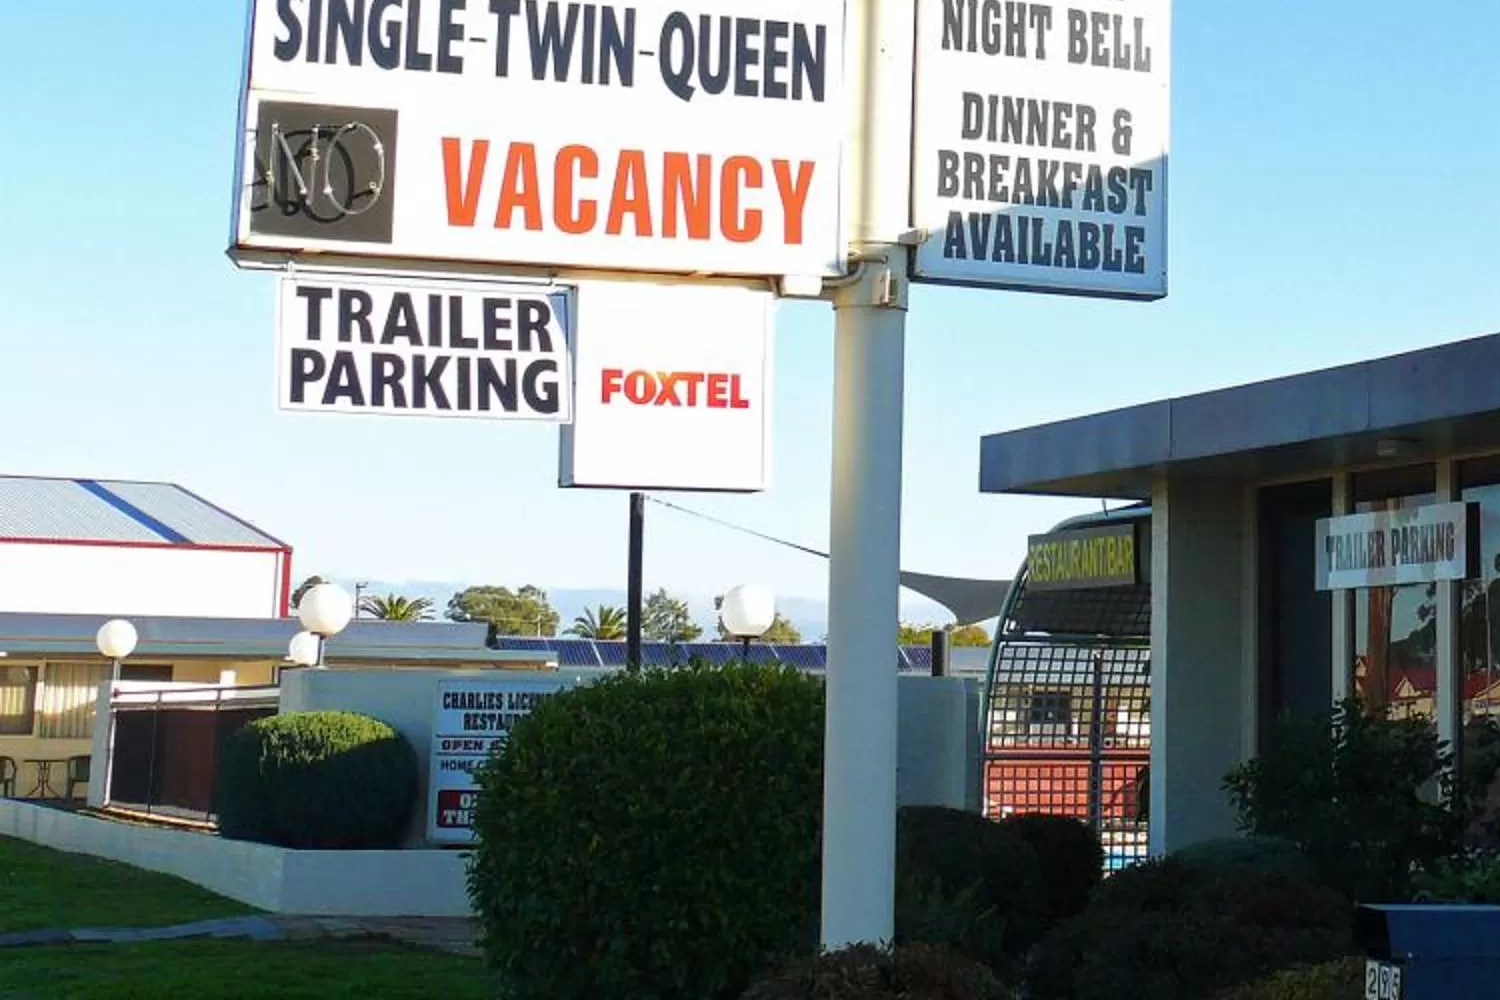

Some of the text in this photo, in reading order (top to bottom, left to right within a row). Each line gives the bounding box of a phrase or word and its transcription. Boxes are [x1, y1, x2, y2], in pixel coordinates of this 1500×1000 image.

[1067, 7, 1151, 73] BELL
[961, 91, 1132, 156] DINNER &
[441, 136, 815, 245] VACANCY
[937, 149, 1152, 217] BREAKFAST
[943, 210, 1146, 274] AVAILABLE
[296, 285, 553, 352] TRAILER
[289, 347, 559, 413] PARKING
[601, 368, 749, 409] FOXTEL
[1326, 521, 1456, 572] TRAILER PARKING
[443, 691, 503, 710] CHARLIES
[442, 740, 483, 750] OPEN
